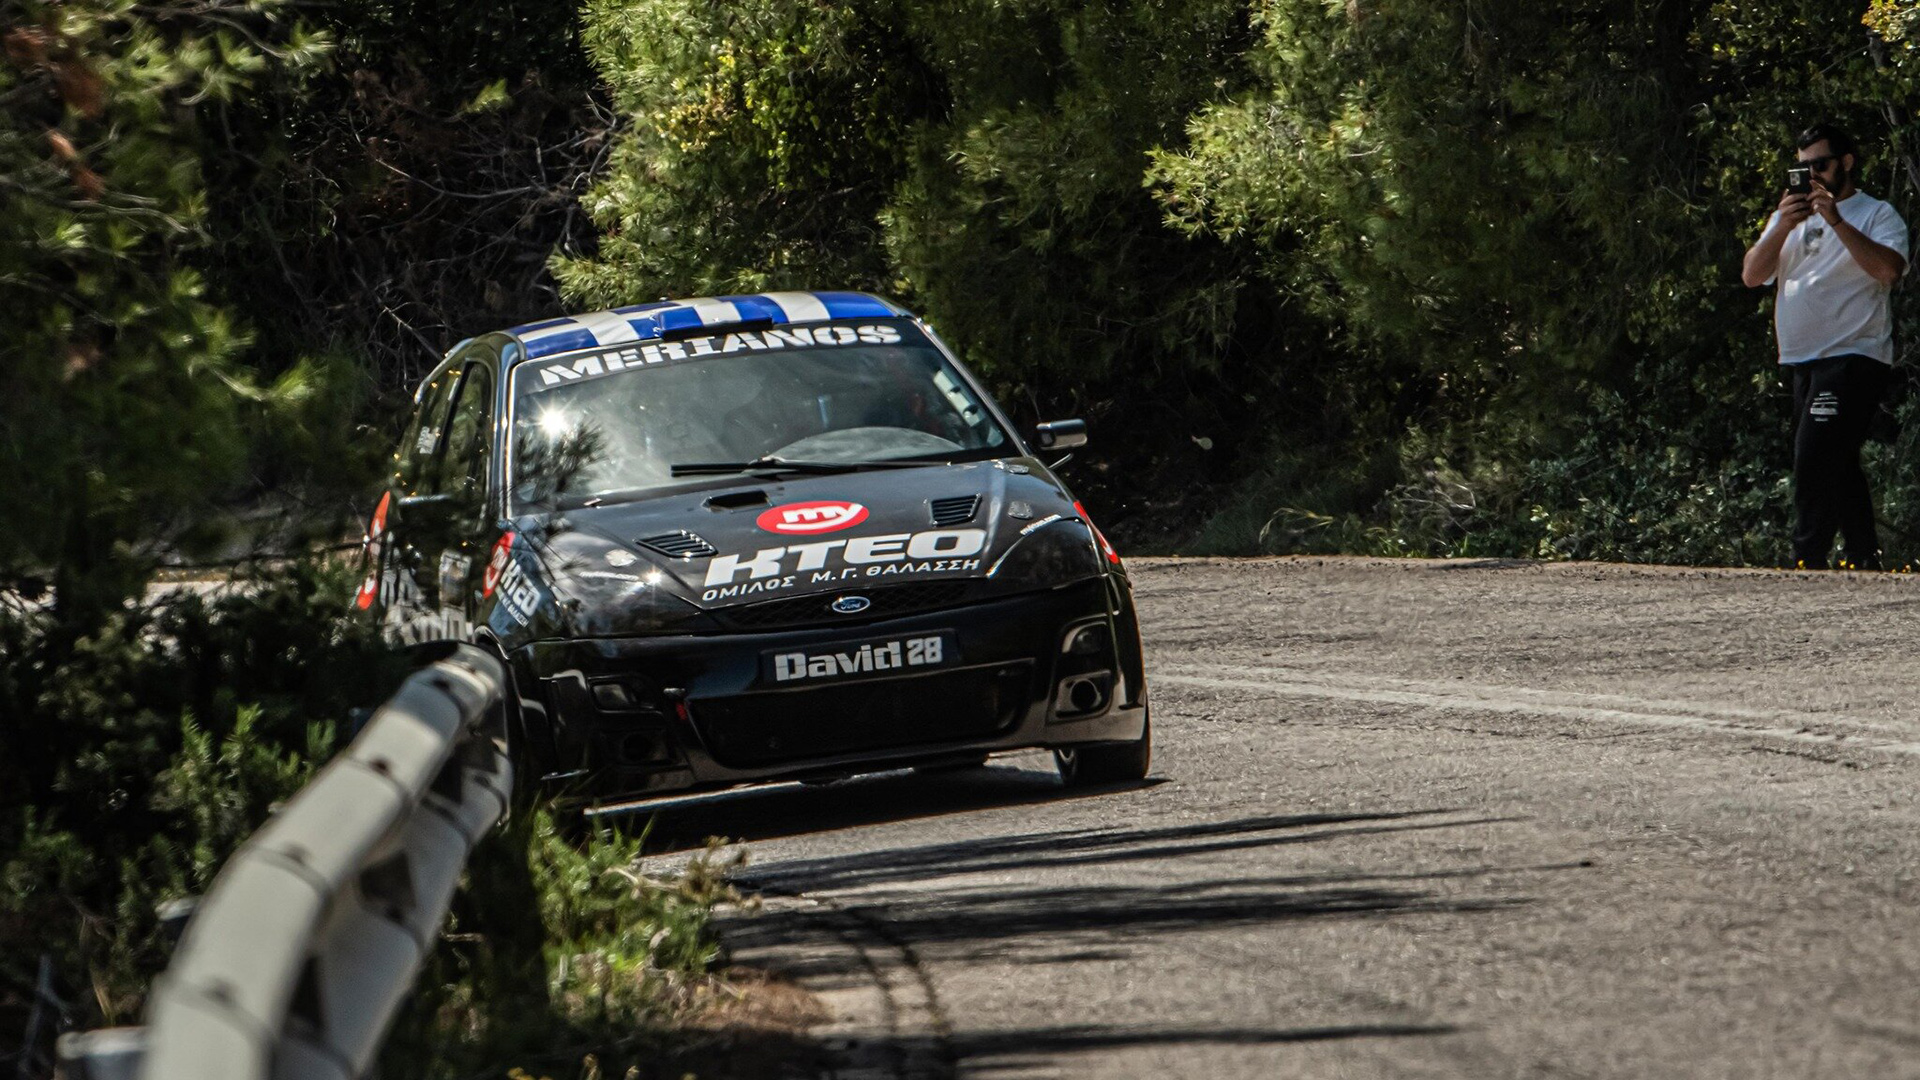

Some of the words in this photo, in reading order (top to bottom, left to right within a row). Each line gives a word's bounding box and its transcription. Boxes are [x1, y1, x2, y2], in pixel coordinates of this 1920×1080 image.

[540, 325, 902, 385] MERIANOS
[775, 502, 864, 531] my
[702, 576, 796, 601] ΟΜΙΛΟΣ
[866, 559, 981, 577] ΘΑΛΑΣΣΗ
[775, 641, 902, 682] David
[907, 636, 943, 666] 28
